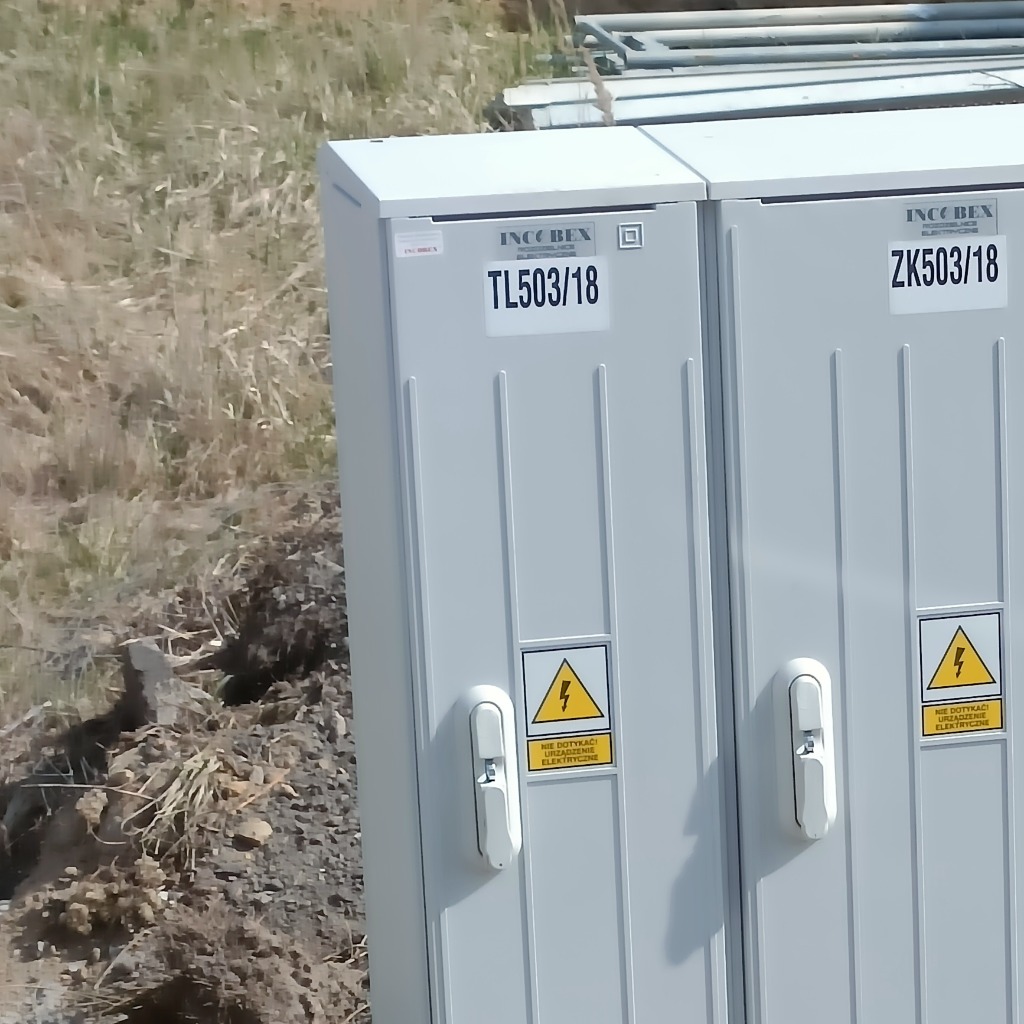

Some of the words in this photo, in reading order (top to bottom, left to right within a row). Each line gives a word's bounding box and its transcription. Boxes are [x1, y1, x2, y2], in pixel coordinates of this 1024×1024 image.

[891, 244, 999, 288] ZK503/18
[487, 265, 599, 309] TL503/18
[936, 719, 989, 730] ELEKTRYCZNE
[541, 754, 598, 765] ELEKTRYCZNE
